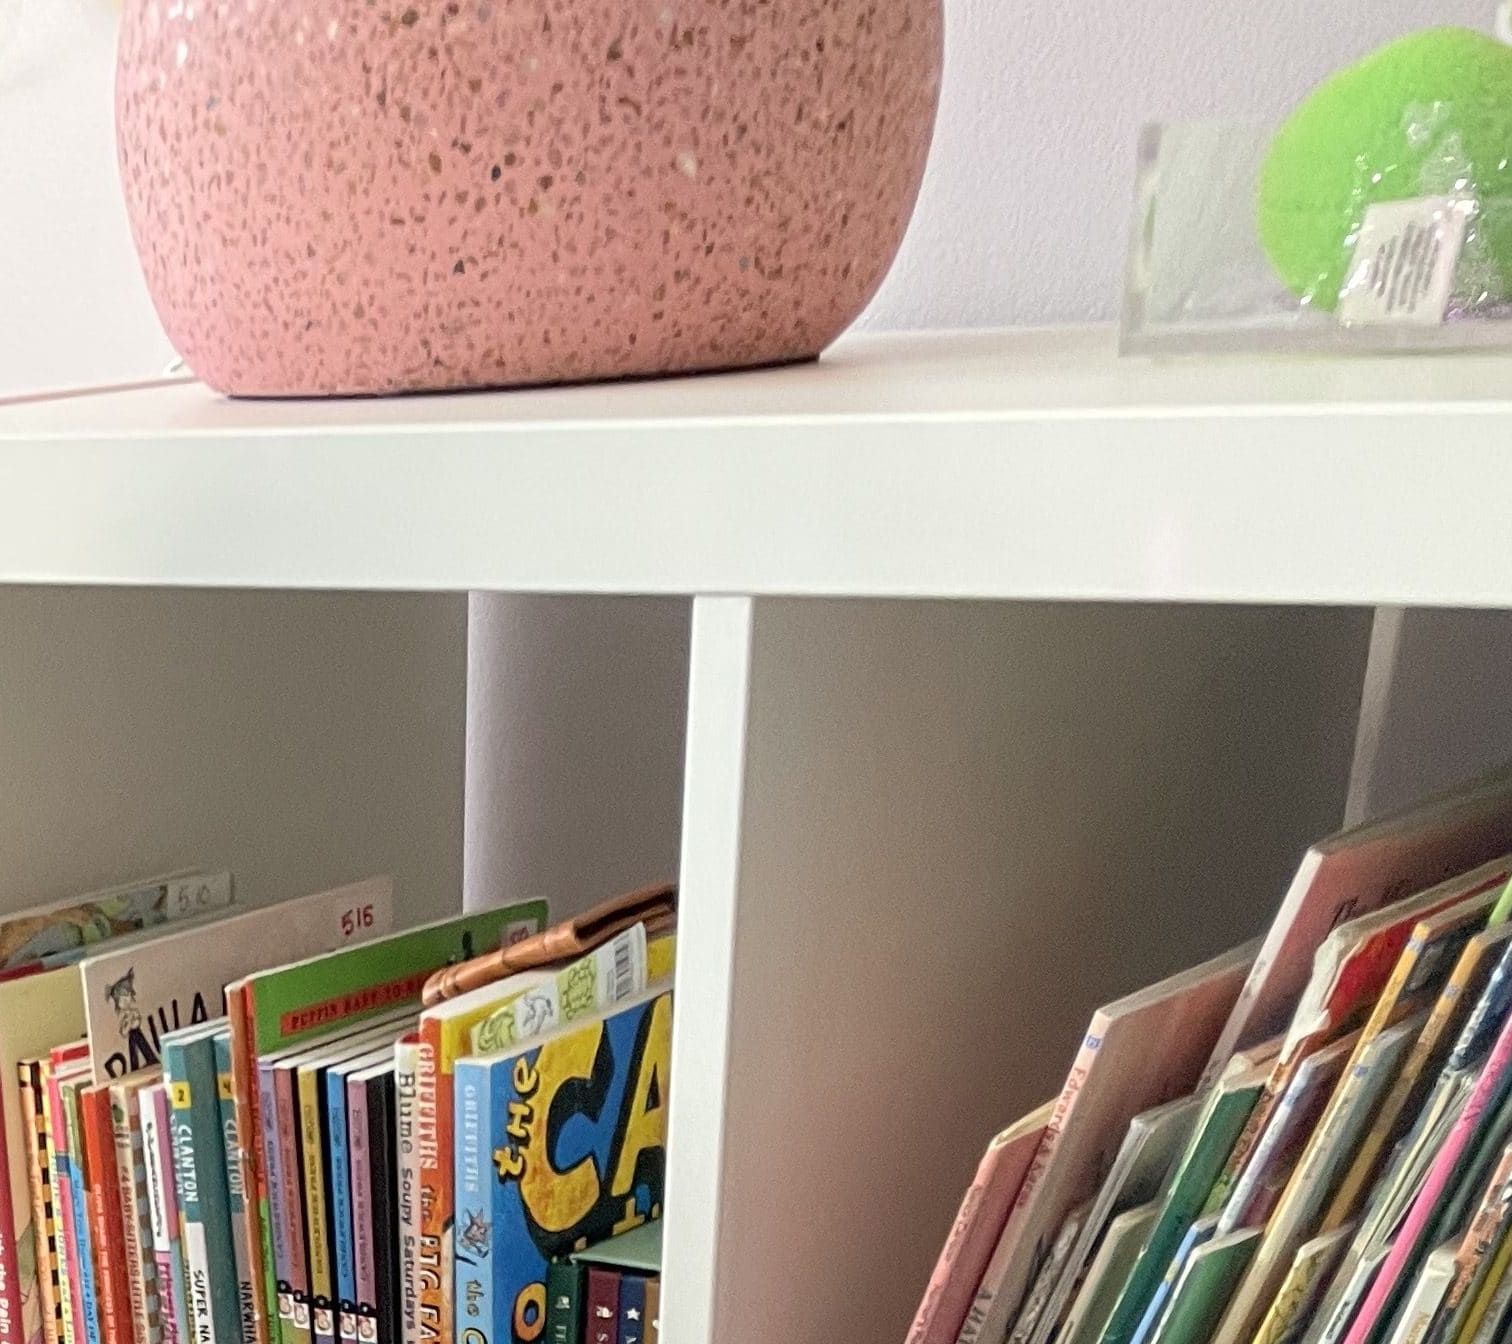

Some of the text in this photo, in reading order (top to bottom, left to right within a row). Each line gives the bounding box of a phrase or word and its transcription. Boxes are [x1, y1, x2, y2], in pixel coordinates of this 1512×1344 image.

[341, 904, 375, 936] 516
[178, 1089, 185, 1102] 2
[399, 1071, 417, 1153] Blume
[416, 1042, 437, 1168] GRIFFITHS
[178, 1124, 198, 1202] CLANTON
[223, 1119, 242, 1195] CLANTON
[463, 1084, 479, 1193] GRIFFITHS
[399, 1167, 414, 1225] Soupy
[420, 1184, 437, 1222] the
[401, 1235, 417, 1328] Saturdays
[418, 1234, 439, 1289] BIG
[193, 1269, 208, 1317] SUPER
[466, 1279, 484, 1316] the
